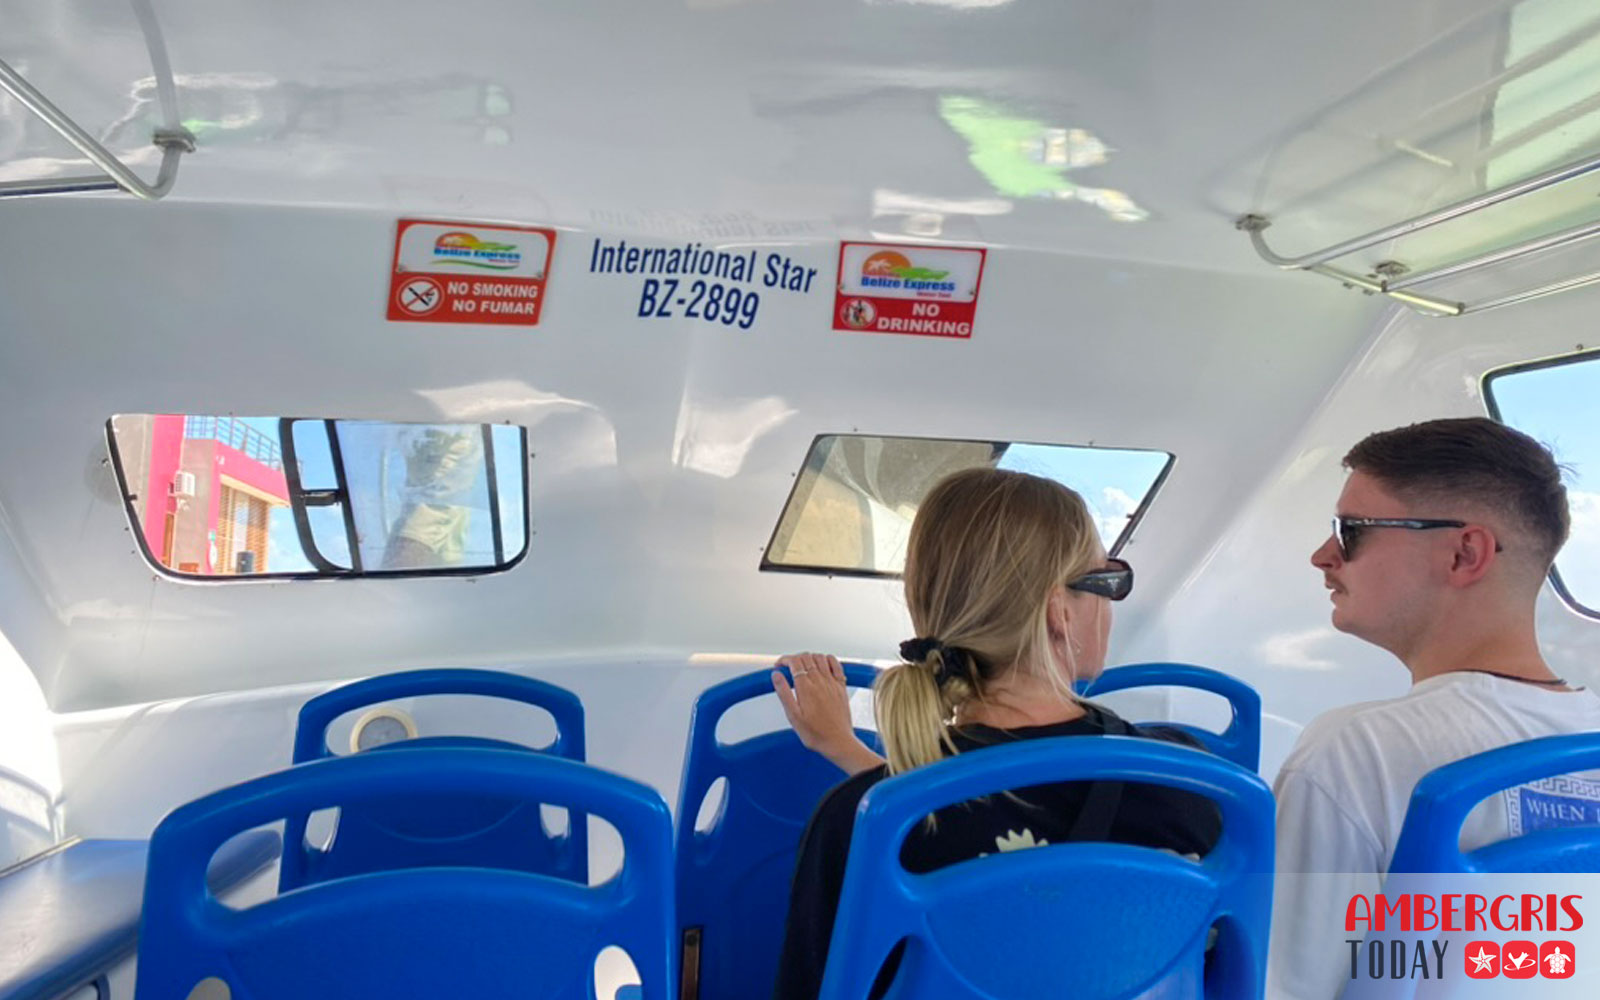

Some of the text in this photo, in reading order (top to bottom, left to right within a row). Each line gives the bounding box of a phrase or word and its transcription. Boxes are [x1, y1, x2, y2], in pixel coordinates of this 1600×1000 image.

[590, 237, 817, 293] International Star
[447, 281, 538, 298] NO SMOKING
[861, 276, 956, 292] Belize Express
[452, 299, 535, 315] NO FUMAR
[637, 278, 760, 330] BZ-2899
[912, 302, 940, 317] NO
[876, 316, 970, 336] DRINKING
[1526, 797, 1585, 821] WHEN
